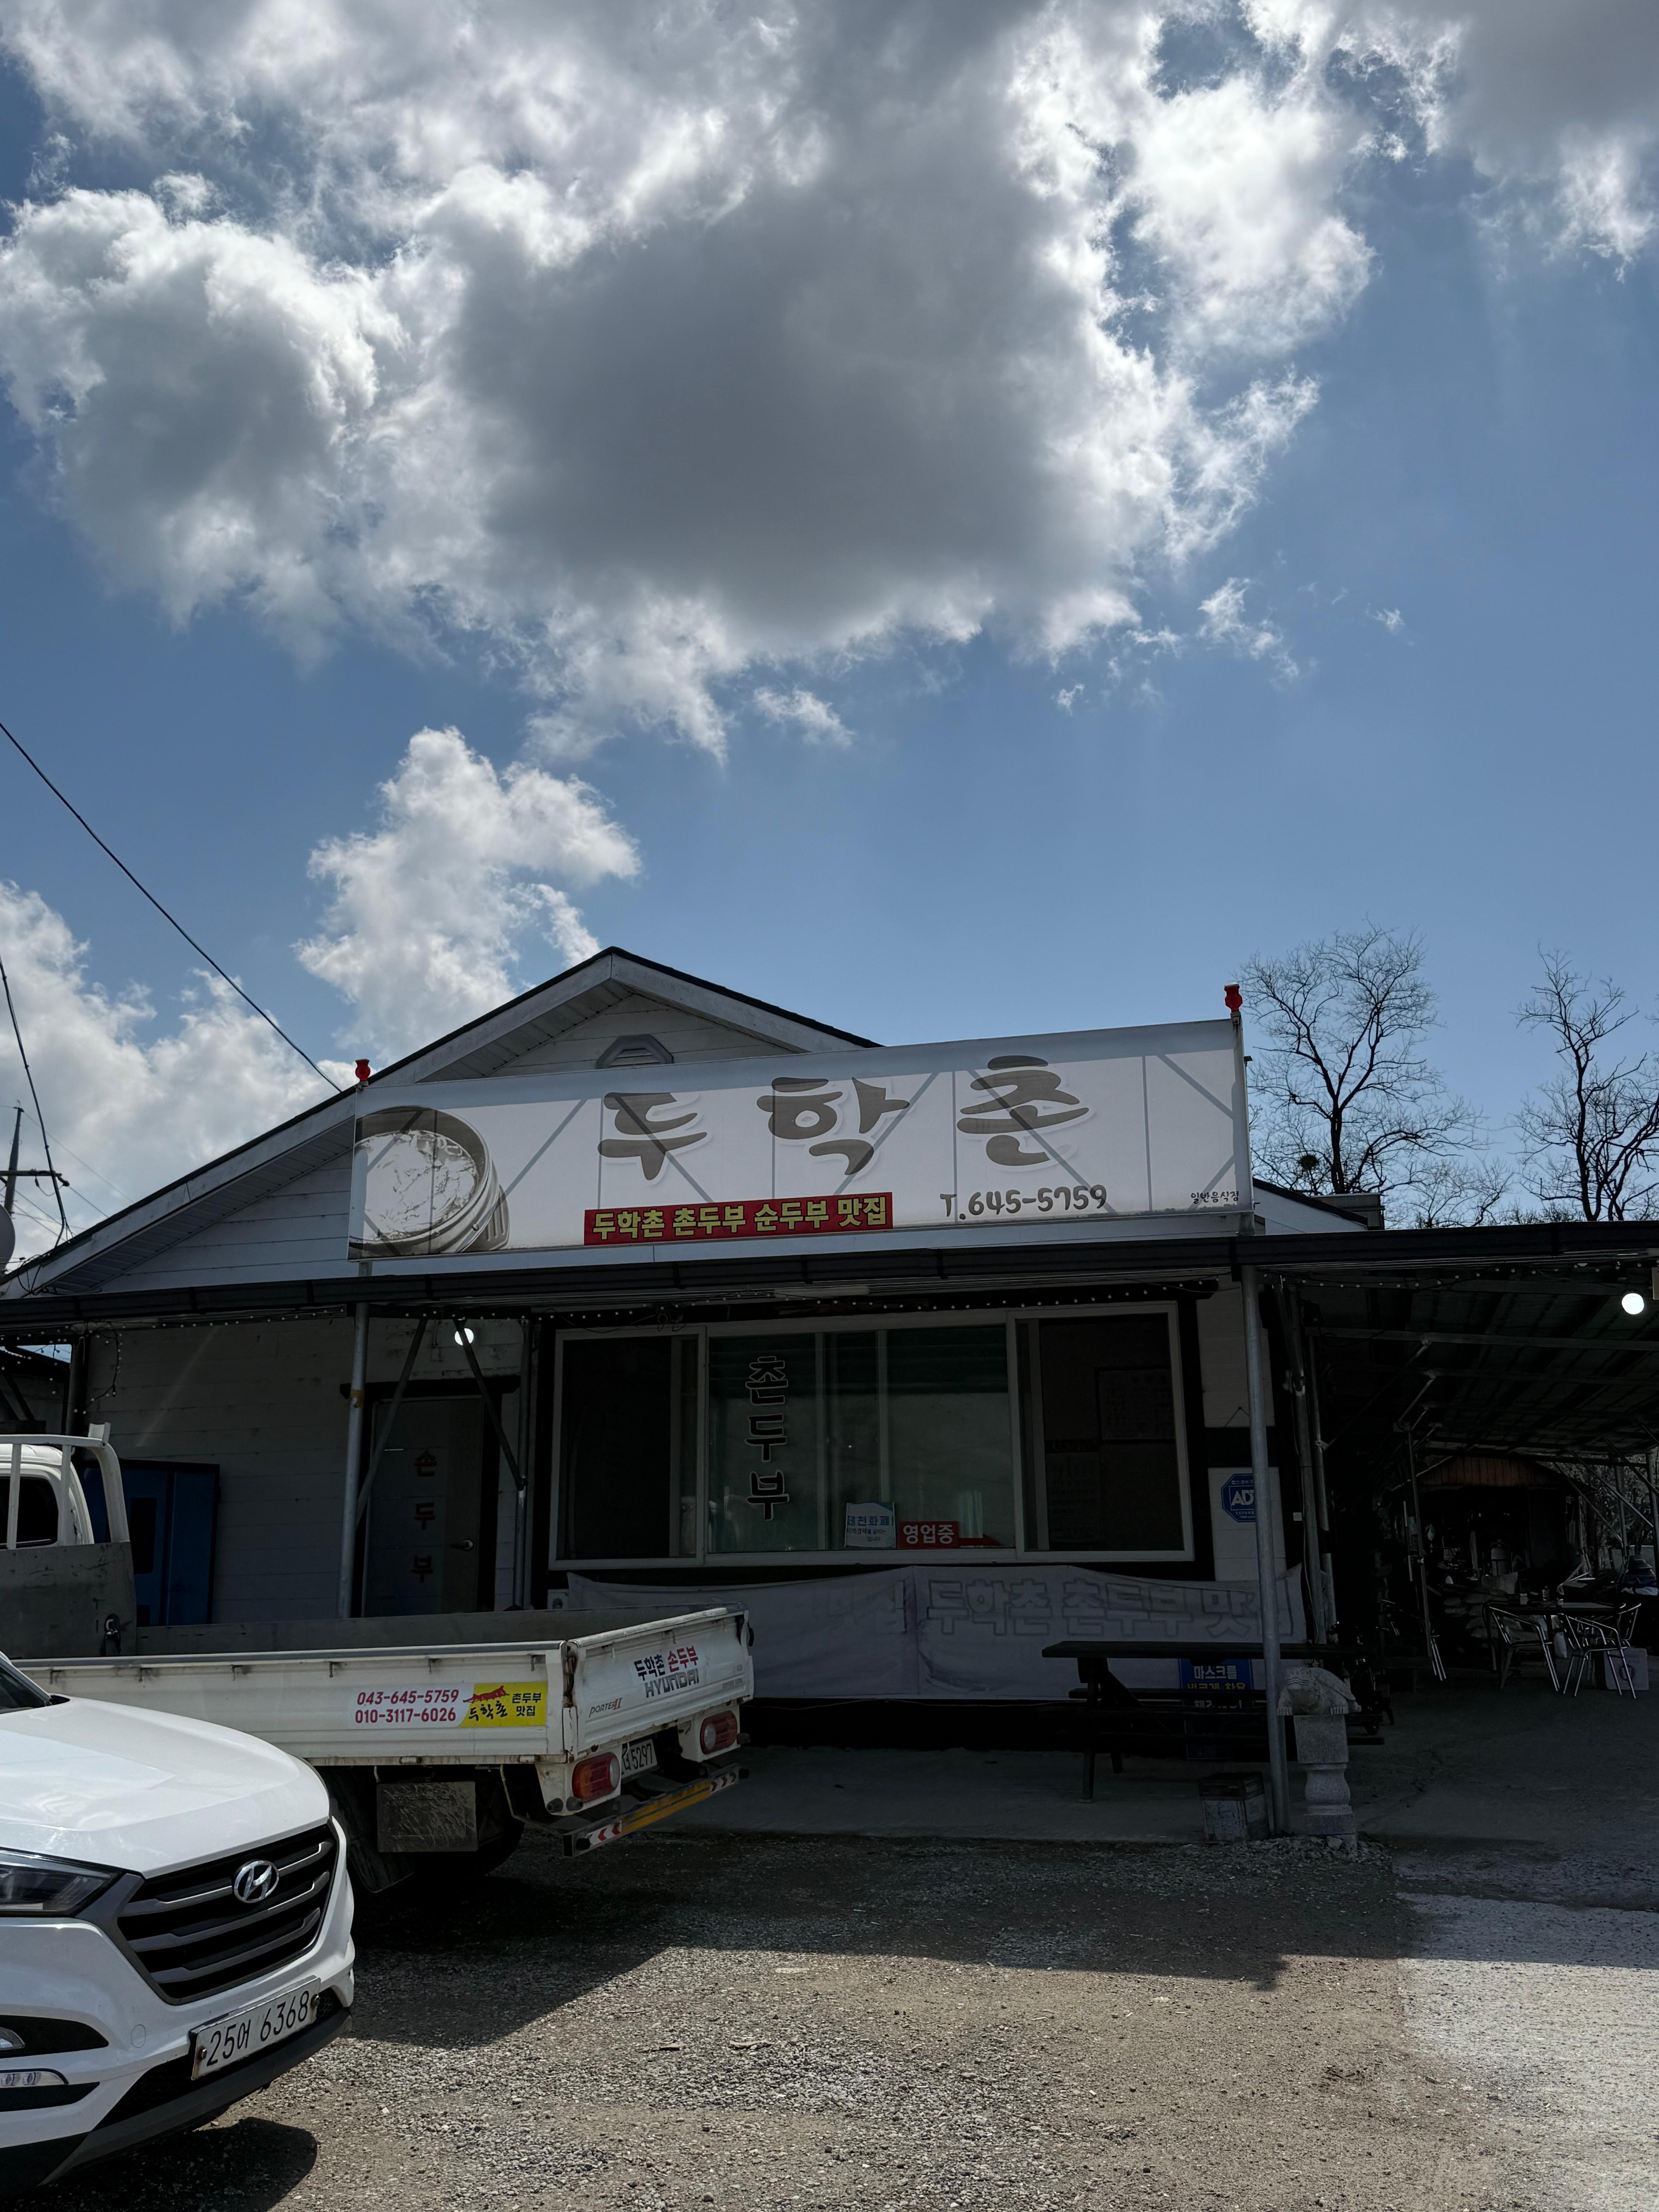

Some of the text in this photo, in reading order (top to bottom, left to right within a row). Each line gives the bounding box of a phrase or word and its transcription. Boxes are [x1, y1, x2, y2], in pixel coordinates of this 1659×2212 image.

[597, 1055, 1089, 1181] 두학촌
[940, 1184, 1107, 1220] T.645-5759
[1190, 1190, 1240, 1204] 일반음식점
[593, 1196, 886, 1240] 두학촌 촌두부 순두부 맛집
[745, 1355, 790, 1521] 촌두부
[1231, 1490, 1254, 1506] AD
[410, 1449, 437, 1583] 손두부
[903, 1524, 955, 1544] 영업중
[927, 1578, 1053, 1636] 두학촌
[1061, 1578, 1194, 1637] 촌두부
[634, 1646, 699, 1681] 두학촌 손두부
[1194, 1665, 1237, 1680] 마스크를
[644, 1668, 699, 1698] HYUNDAI
[357, 1689, 459, 1705] 043-645-5759
[512, 1692, 541, 1704] 촌두부
[356, 1707, 456, 1723] 010-3117-6026
[469, 1700, 508, 1721] 두학촌
[516, 1705, 536, 1716] 맛집
[630, 1743, 653, 1769] 5297
[206, 1990, 309, 2066] 25어 6368
